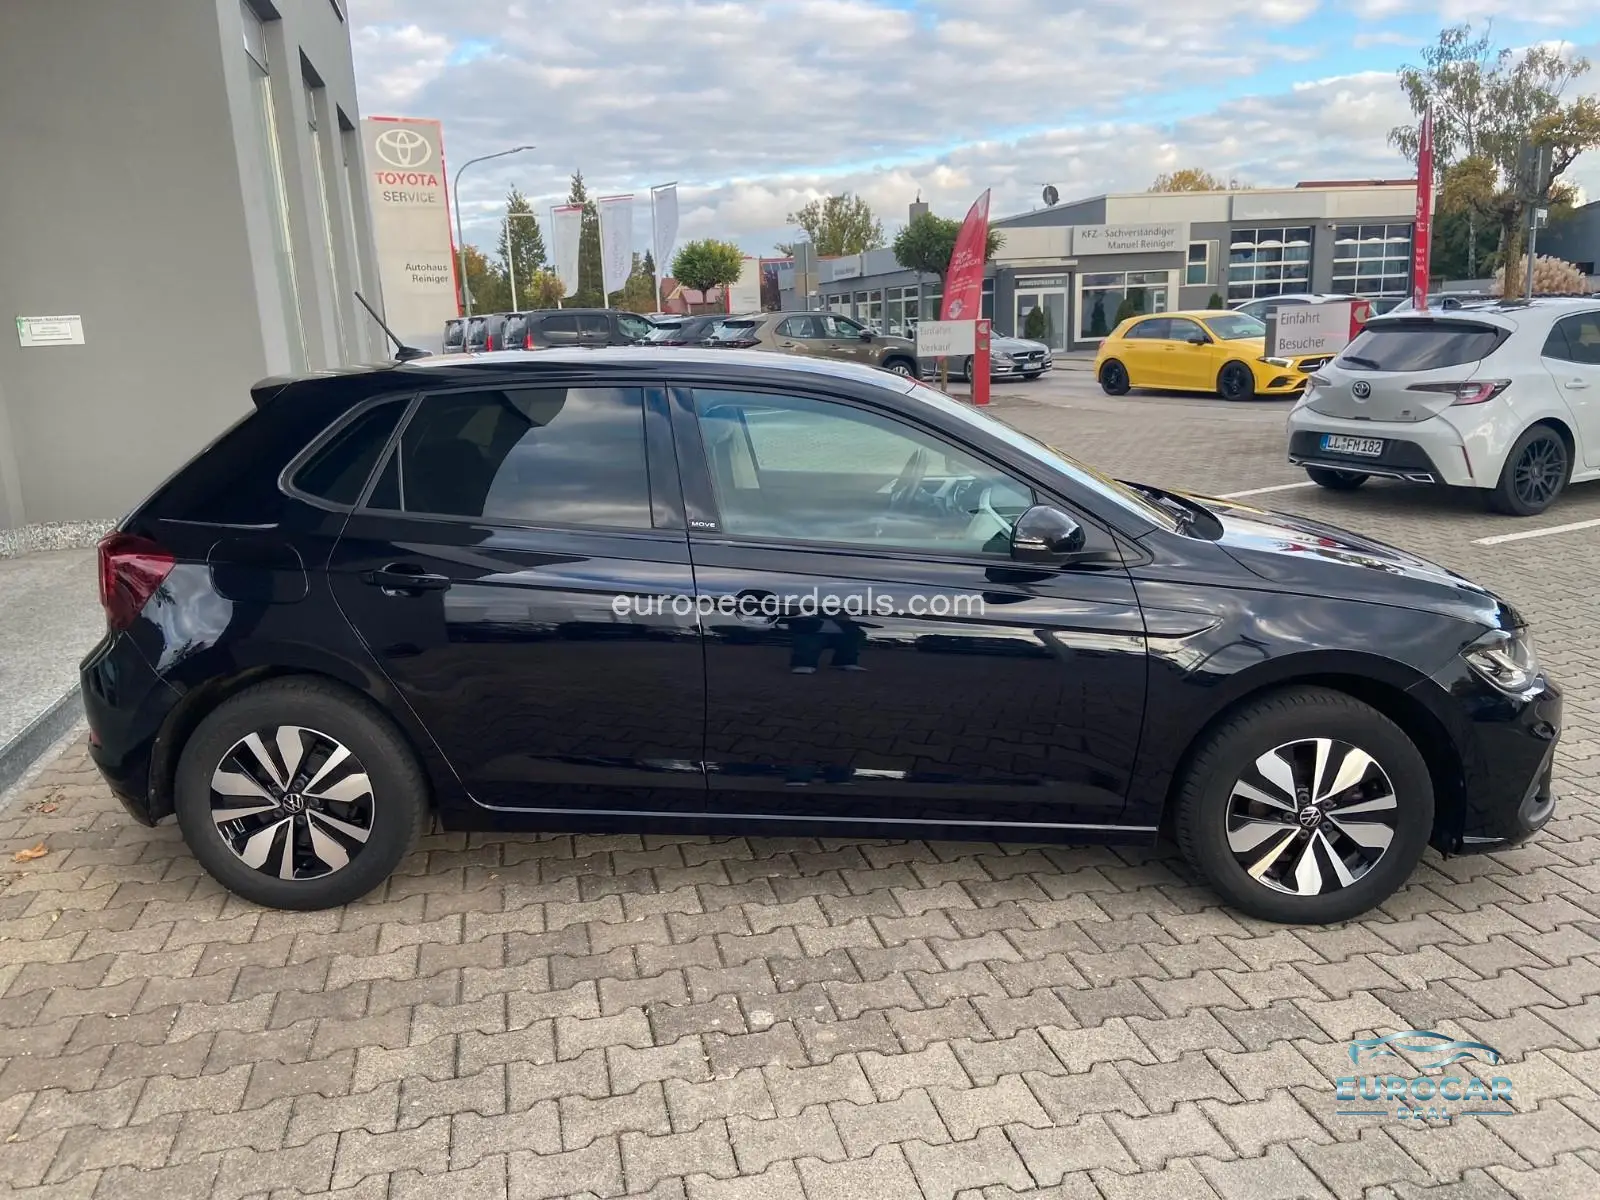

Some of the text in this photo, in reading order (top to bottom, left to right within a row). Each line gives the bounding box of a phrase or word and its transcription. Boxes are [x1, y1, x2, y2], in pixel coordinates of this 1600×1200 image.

[375, 172, 438, 186] TOYOTA
[383, 191, 436, 203] SERVICE
[1081, 229, 1099, 239] KFZ
[1107, 240, 1175, 250] Manuel Reiniger
[405, 263, 448, 271] Autohaus
[412, 274, 448, 284] Reiniger
[1280, 312, 1321, 325] Einfahrt
[1279, 337, 1325, 350] Besucher
